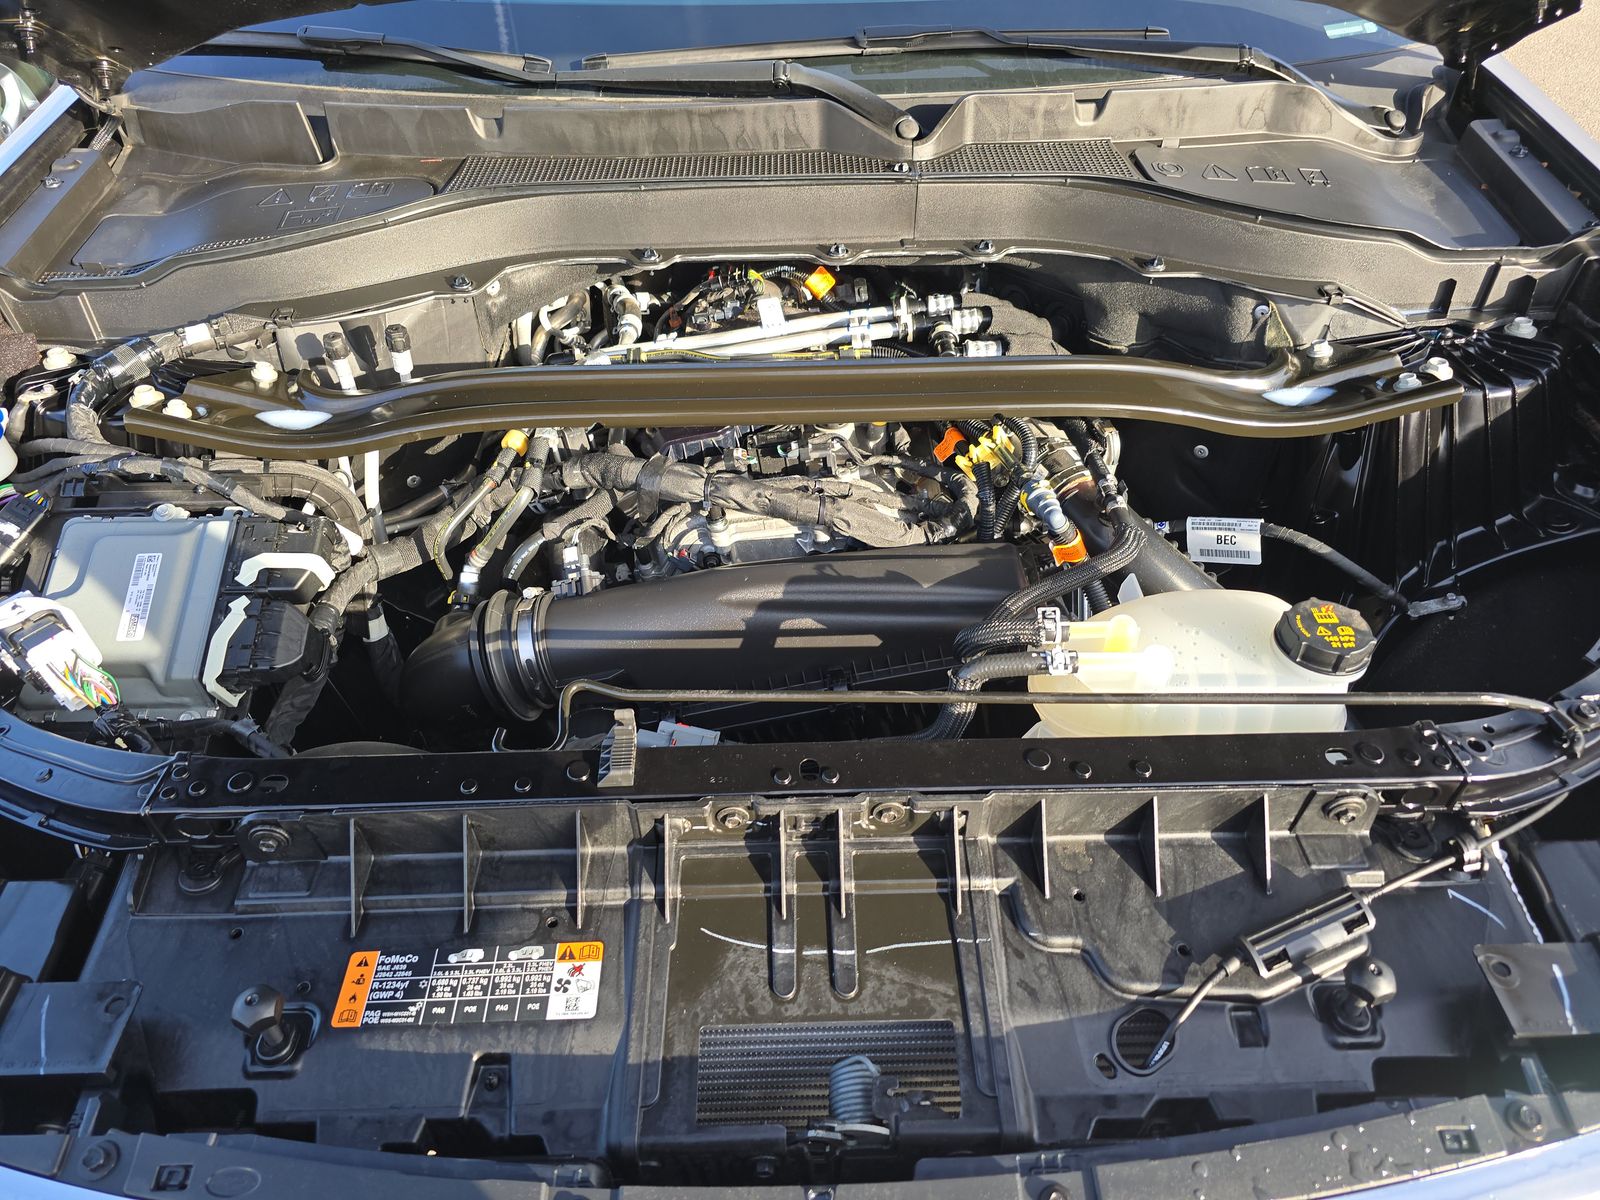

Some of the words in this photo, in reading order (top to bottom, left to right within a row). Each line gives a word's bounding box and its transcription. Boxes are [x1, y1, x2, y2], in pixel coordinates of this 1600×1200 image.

[1216, 534, 1236, 545] BEC
[378, 954, 419, 964] FoMoCo
[449, 978, 458, 987] kg
[479, 977, 488, 986] kg
[512, 975, 521, 983] kg
[543, 974, 551, 982] kg
[372, 980, 410, 990] R-1234yf
[369, 991, 394, 1000] (GWP
[394, 991, 404, 999] 4)
